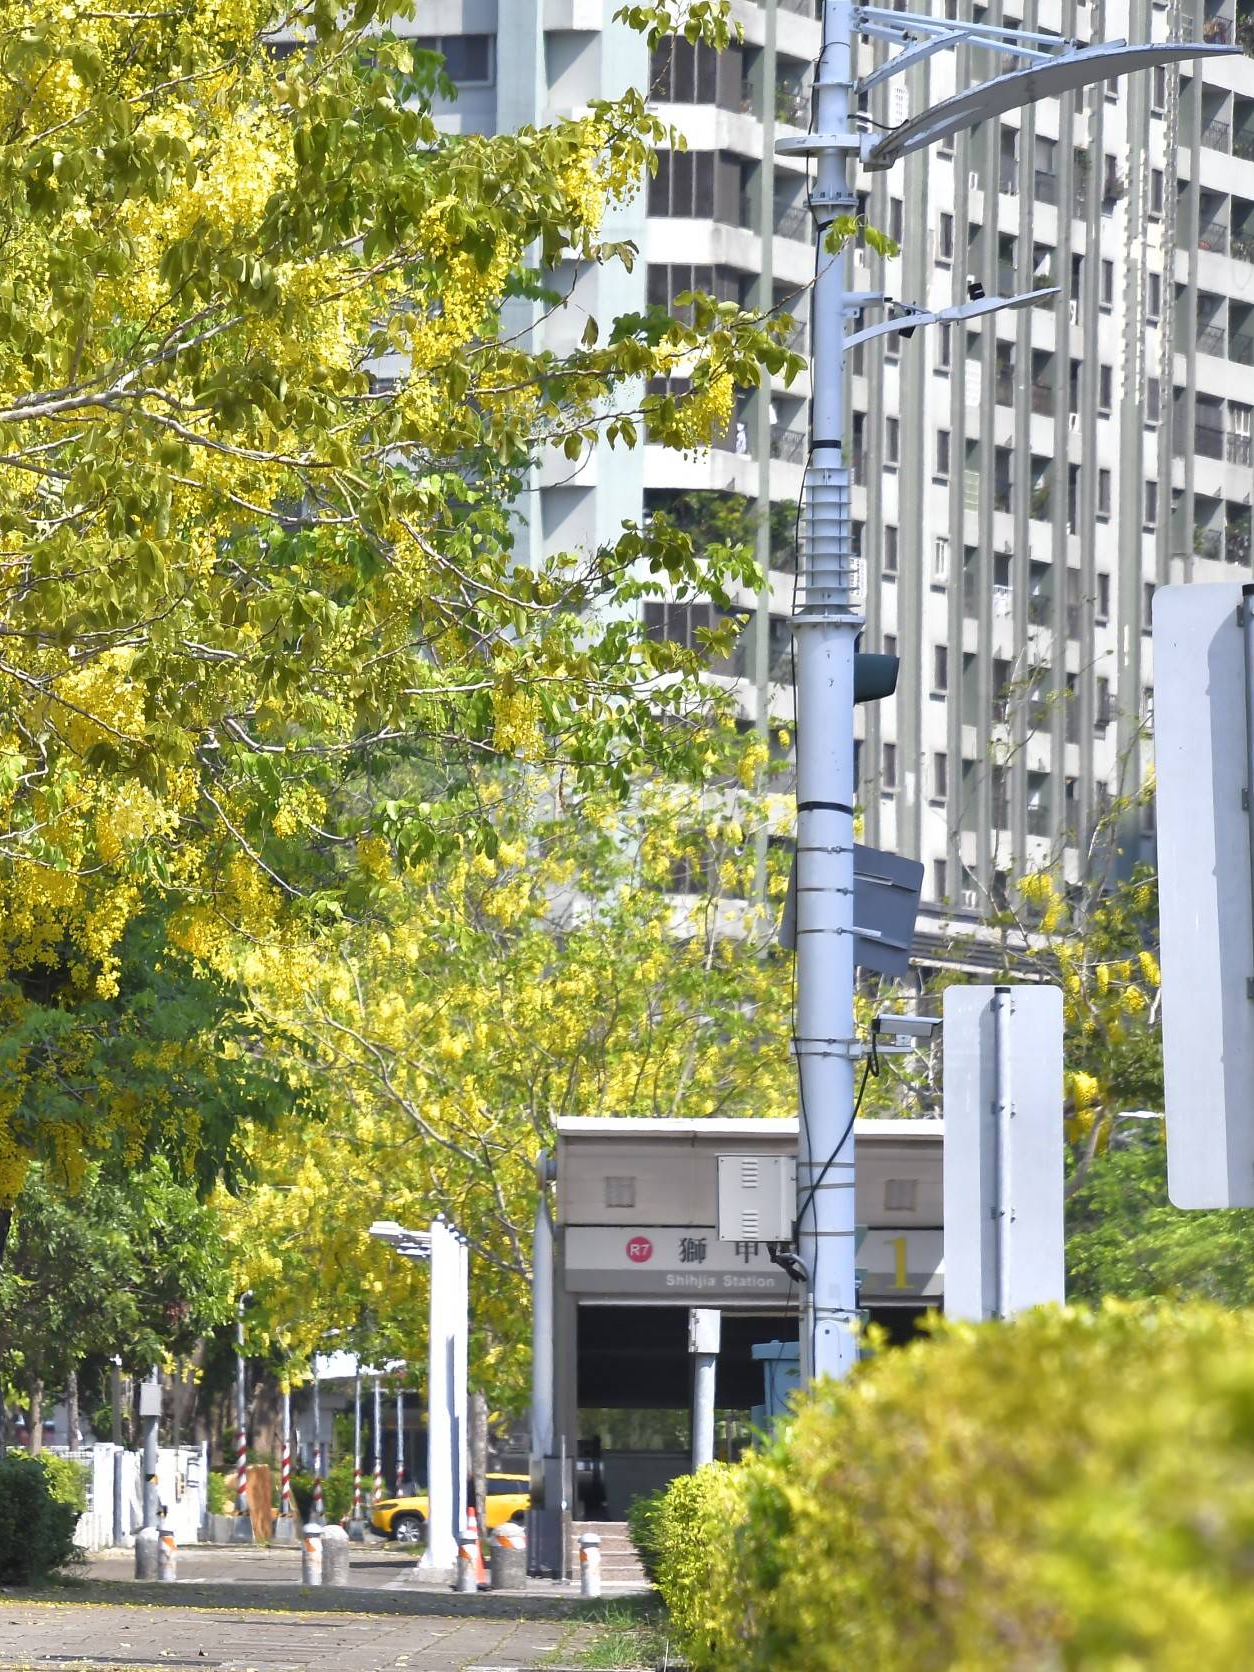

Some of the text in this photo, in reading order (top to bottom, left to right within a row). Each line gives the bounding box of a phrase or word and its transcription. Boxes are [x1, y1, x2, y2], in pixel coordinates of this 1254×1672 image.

[630, 1244, 650, 1257] R7
[883, 1236, 916, 1289] 1
[666, 1274, 775, 1289] Shihjia Station
